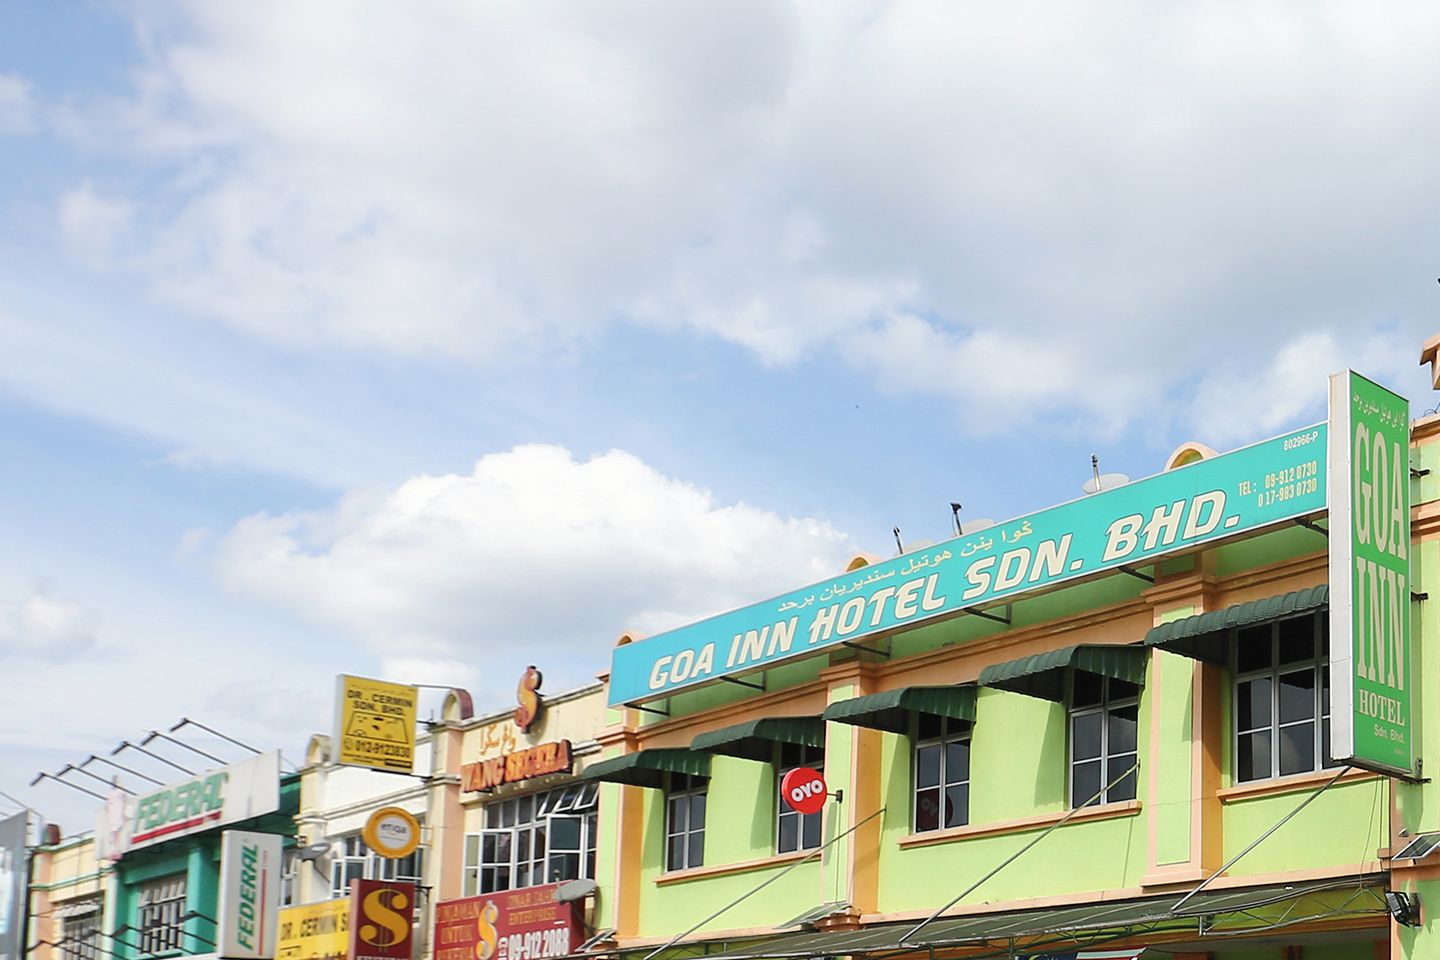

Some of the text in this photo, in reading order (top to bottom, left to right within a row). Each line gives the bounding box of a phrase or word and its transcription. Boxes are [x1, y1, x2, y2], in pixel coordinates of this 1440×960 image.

[1265, 467, 1295, 488] 09-912
[1296, 460, 1317, 480] 0730
[1296, 478, 1317, 497] 0730
[1355, 422, 1406, 561] GOA
[648, 490, 1241, 691] GOA INN HOTEL SDN. BHD.
[1356, 556, 1405, 691] INN
[1359, 689, 1405, 727] HOTEL
[791, 779, 823, 802] OYO
[237, 844, 258, 950] FEDERAL
[542, 927, 570, 958] 2088
